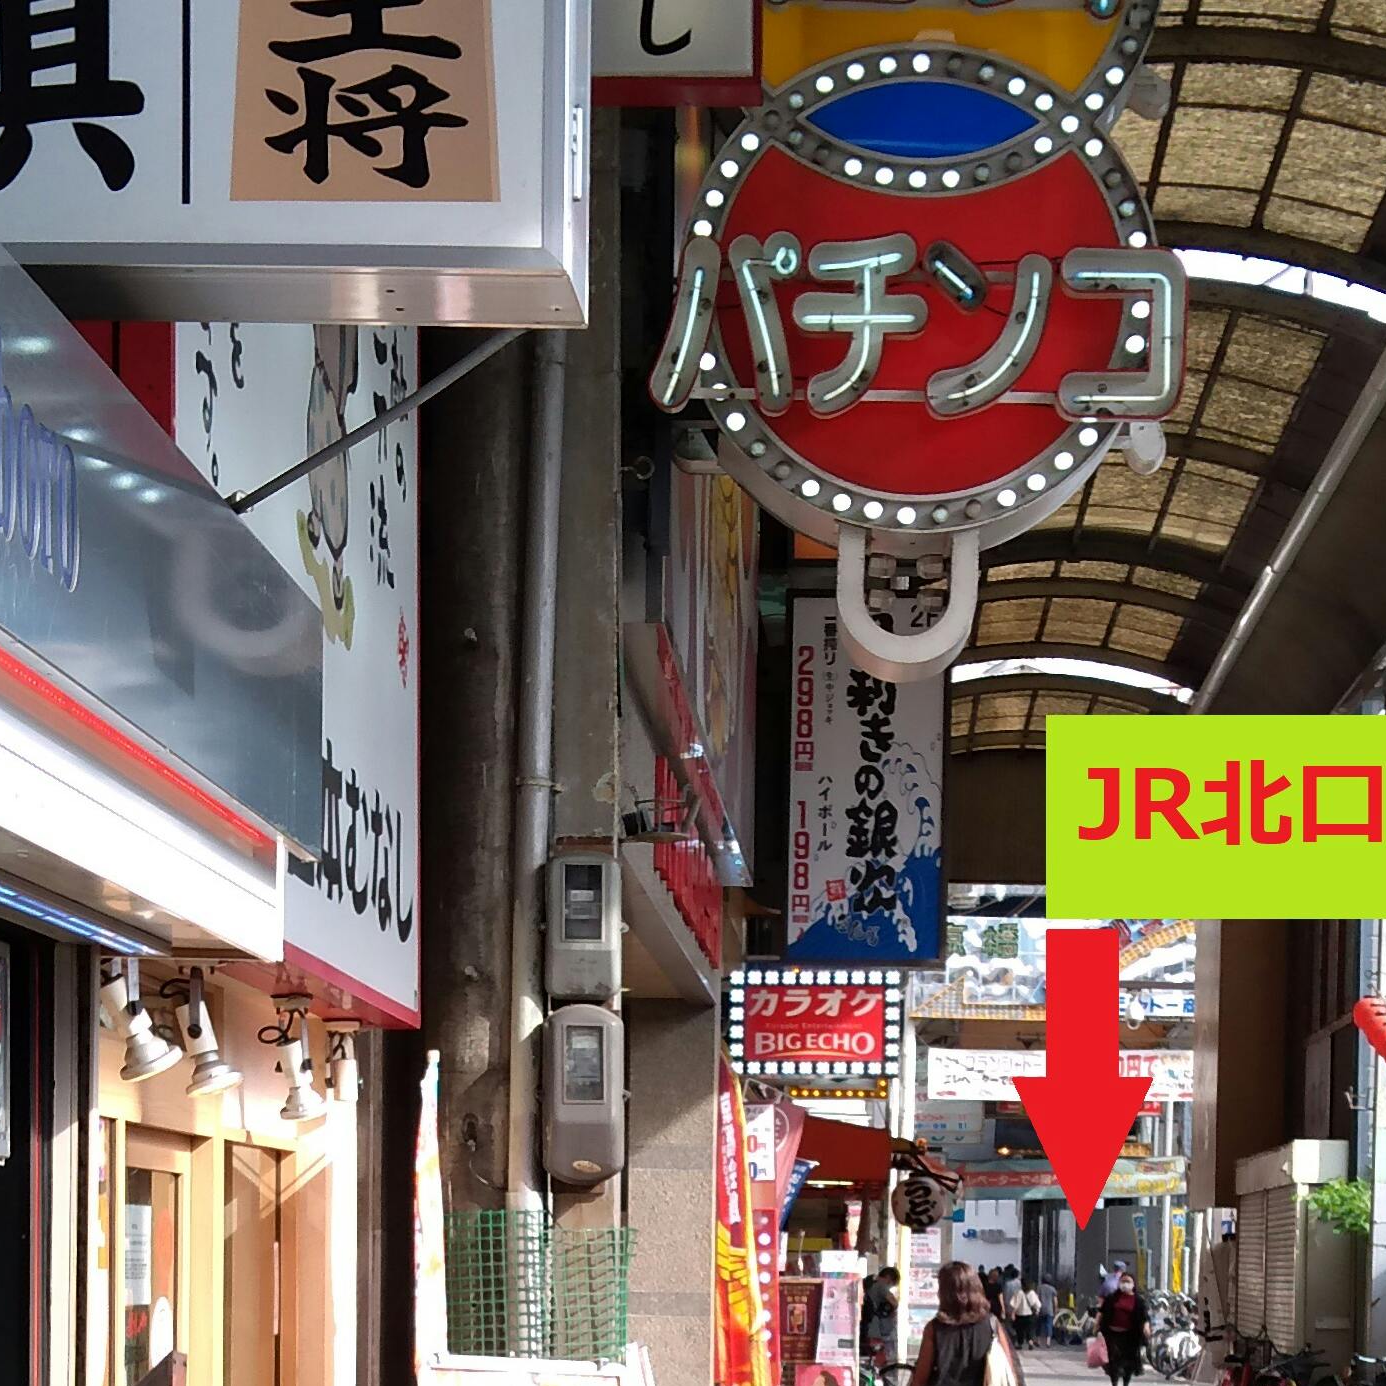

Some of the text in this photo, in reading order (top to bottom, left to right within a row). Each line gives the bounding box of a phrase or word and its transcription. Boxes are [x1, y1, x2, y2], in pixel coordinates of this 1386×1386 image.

[649, 231, 1189, 422] パチンコ
[794, 645, 815, 760] 298円
[791, 800, 811, 914] 198円
[818, 775, 834, 852] ハイボール
[749, 988, 883, 1018] カラオケ
[754, 1031, 876, 1055] BIG ECHO
